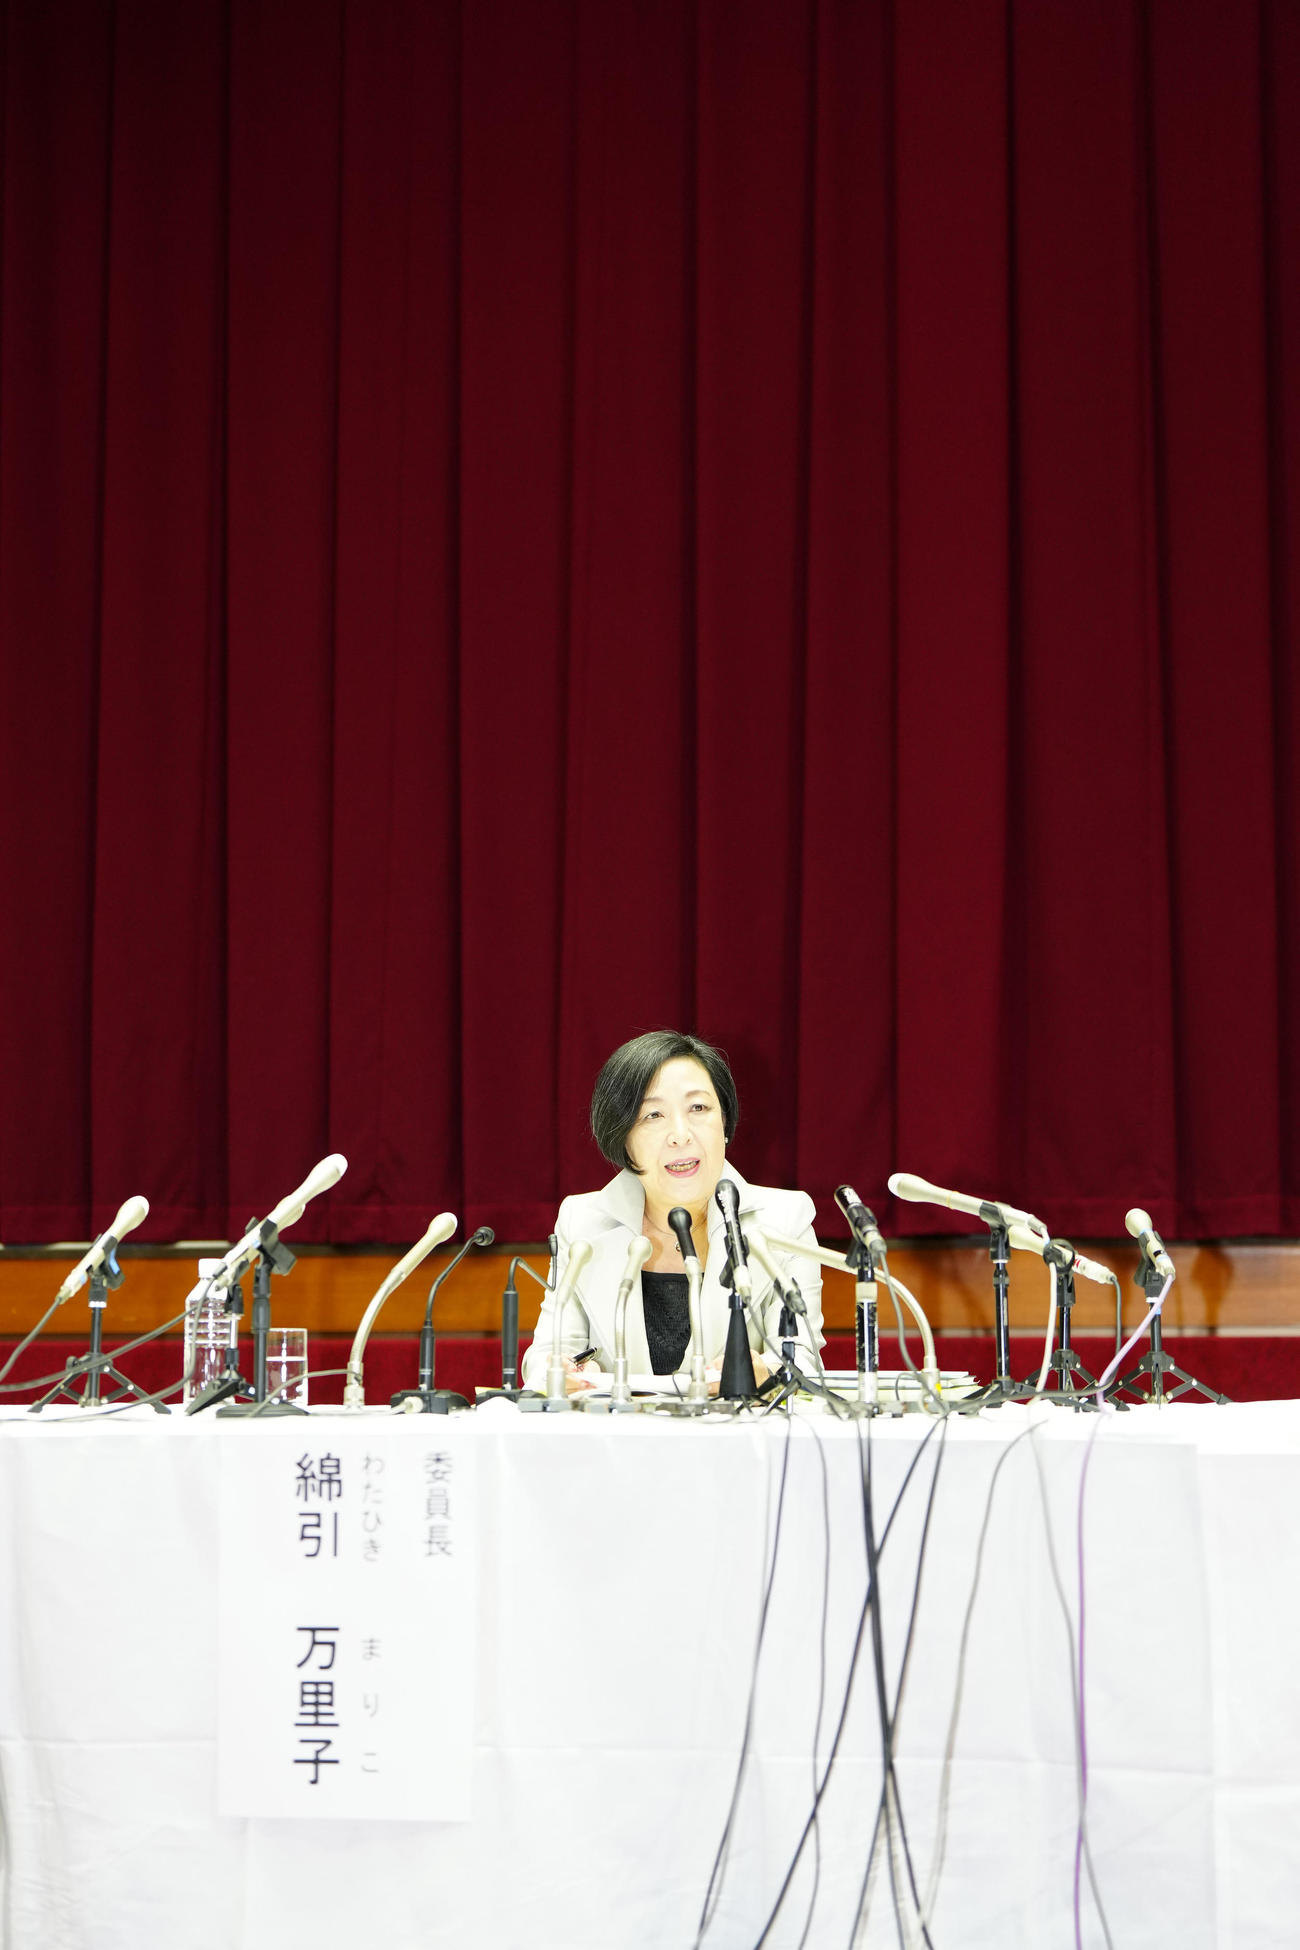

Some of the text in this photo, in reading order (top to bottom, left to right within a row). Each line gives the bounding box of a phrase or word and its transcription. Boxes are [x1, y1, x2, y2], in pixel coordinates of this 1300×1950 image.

[362, 1453, 385, 1563] わたひき
[424, 1452, 453, 1557] 委員長
[293, 1452, 343, 1786] 綿引 万里子
